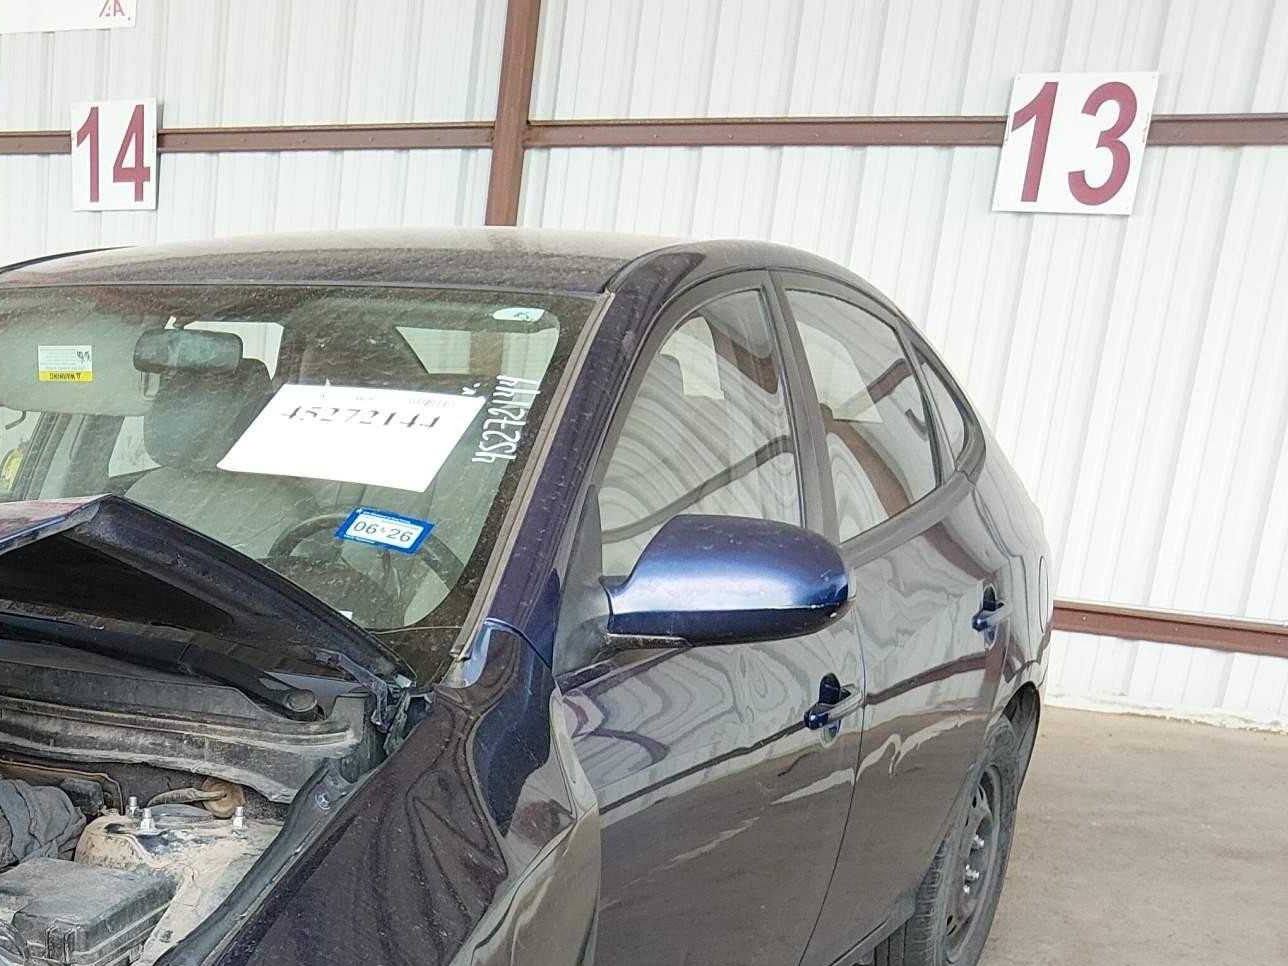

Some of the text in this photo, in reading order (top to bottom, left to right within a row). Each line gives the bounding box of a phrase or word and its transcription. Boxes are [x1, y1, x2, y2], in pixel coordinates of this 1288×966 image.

[76, 104, 152, 203] 14
[1010, 81, 1138, 207] 13
[353, 520, 380, 535] 06
[386, 527, 414, 543] 26
